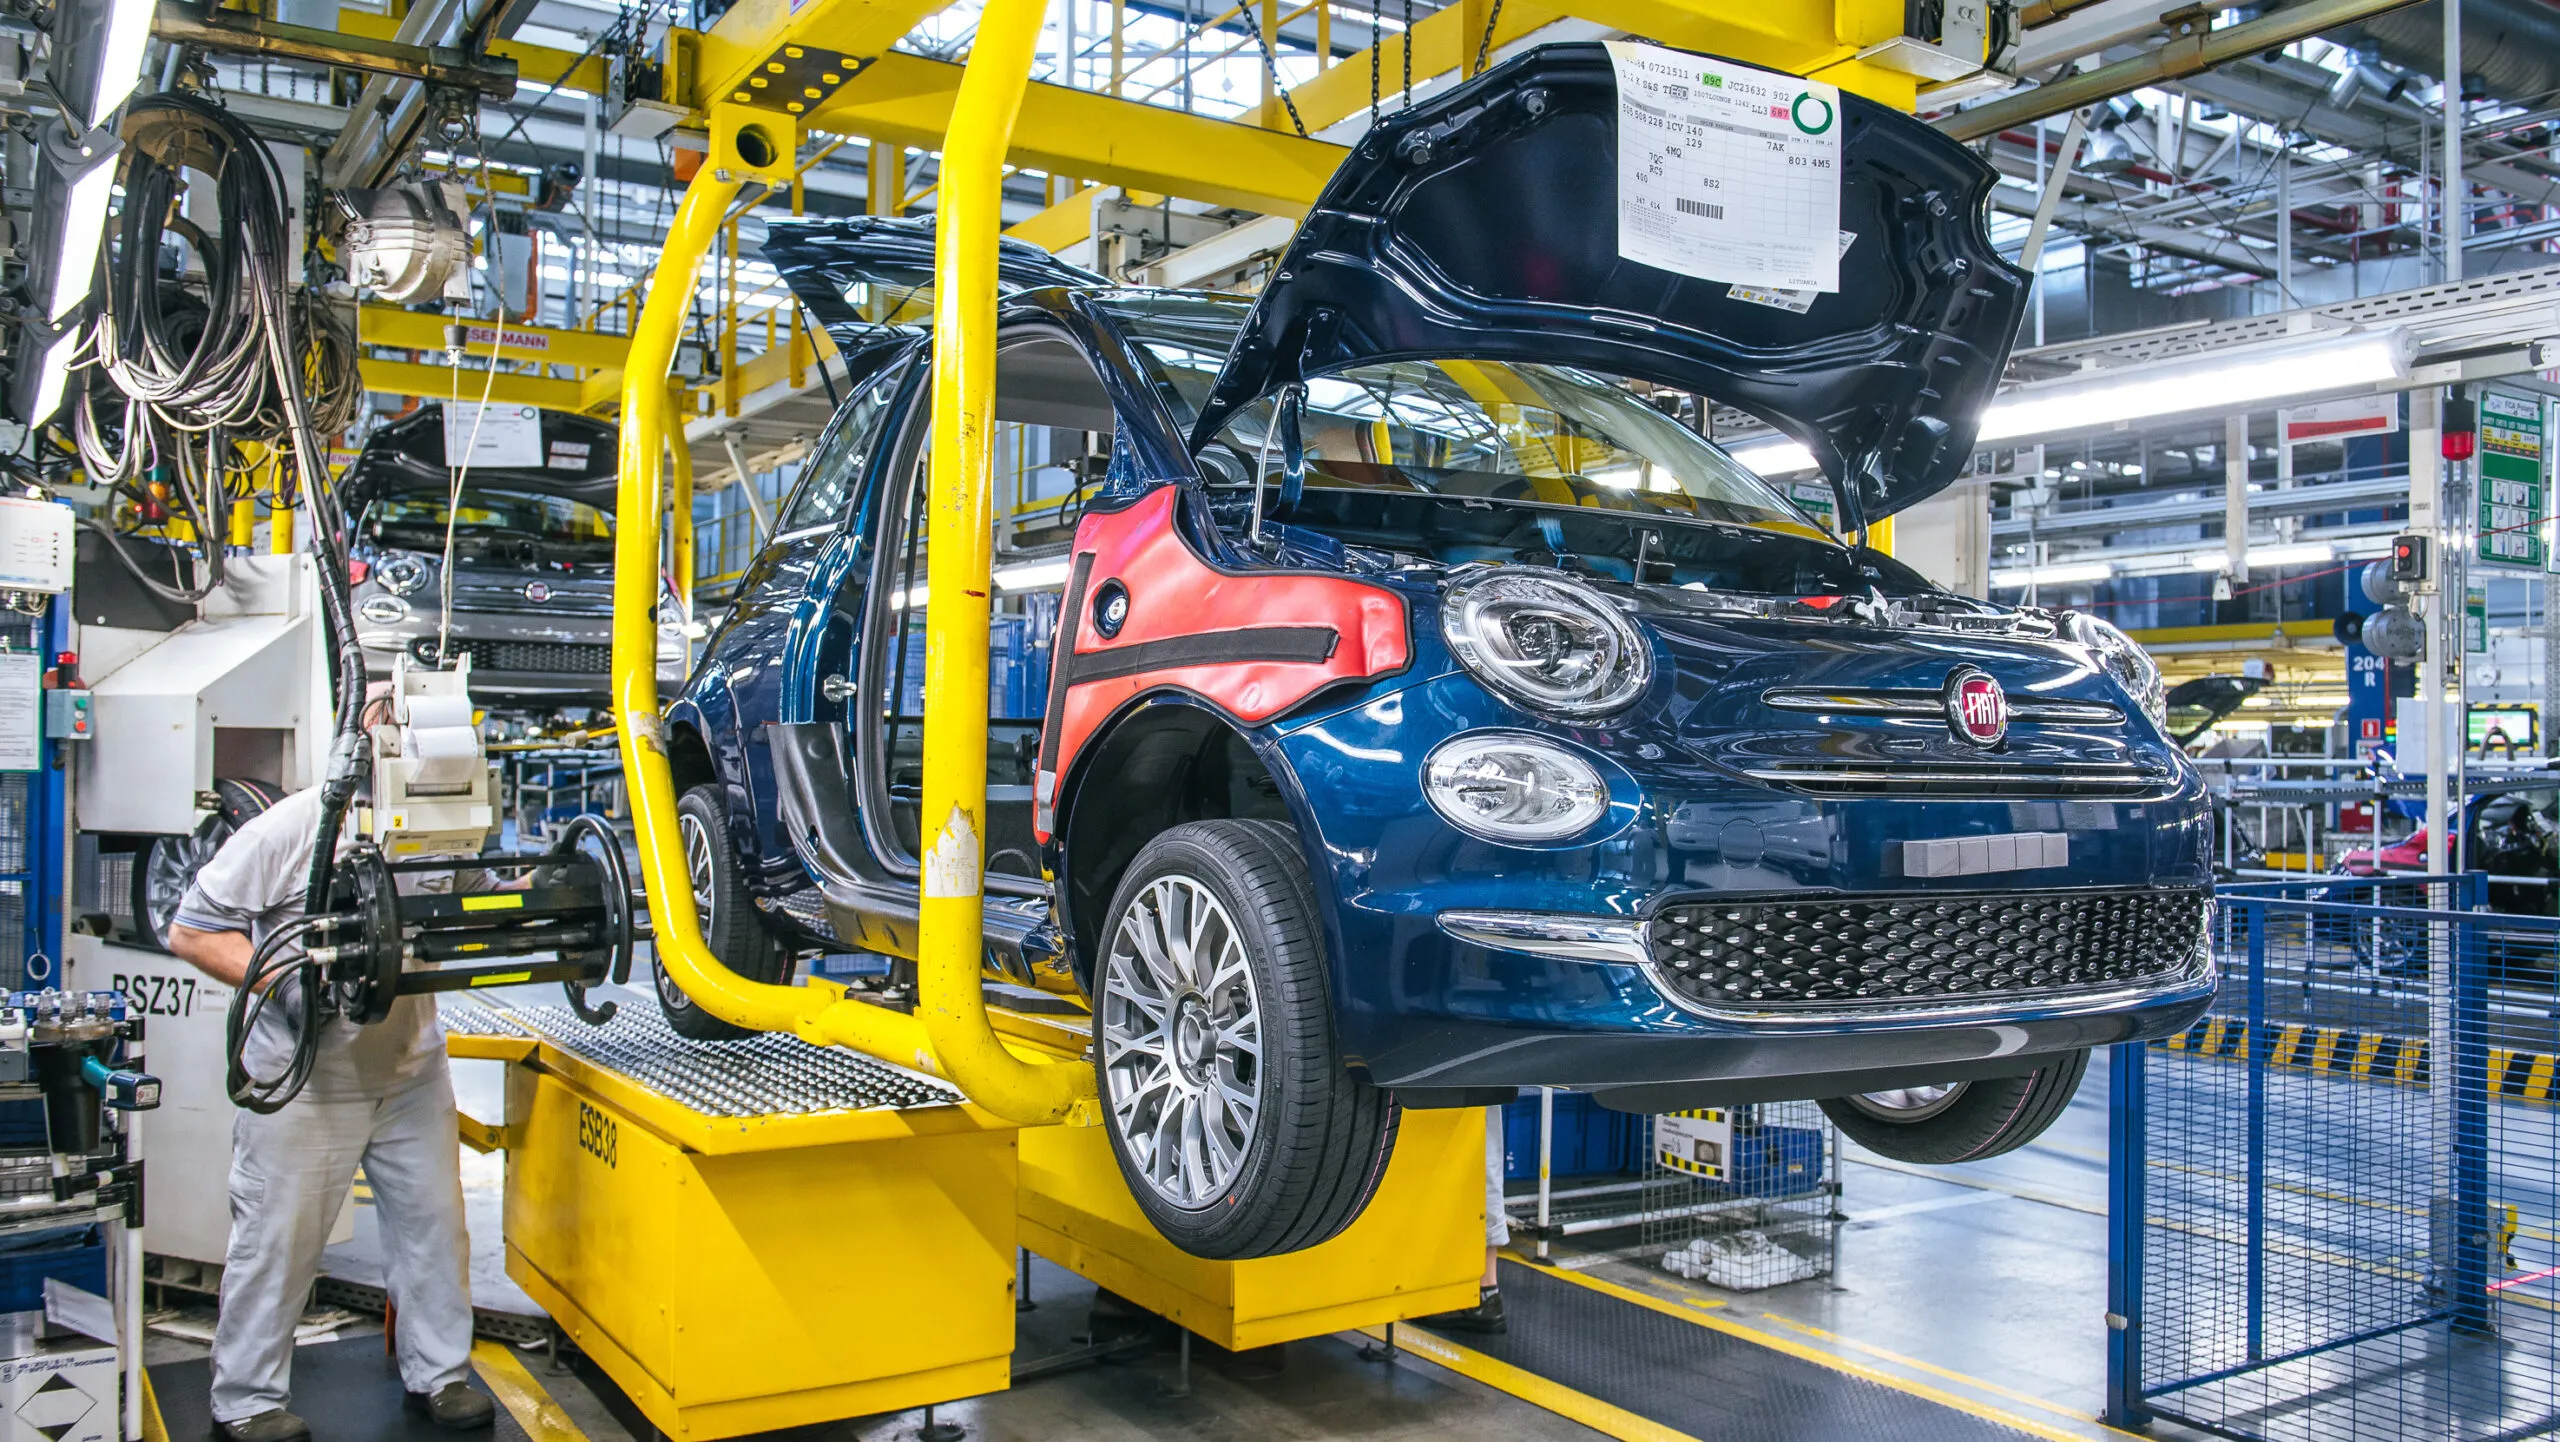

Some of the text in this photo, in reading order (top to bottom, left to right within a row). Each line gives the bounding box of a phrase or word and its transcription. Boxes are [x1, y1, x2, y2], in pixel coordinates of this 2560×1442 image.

[1649, 62, 1689, 79] 0721511
[1695, 73, 1700, 82] 4
[1703, 75, 1721, 87] 09C
[1728, 81, 1767, 97] JC23632
[1773, 91, 1790, 102] 902
[1643, 80, 1659, 92] S&S
[1752, 105, 1768, 116] LL3
[1770, 107, 1789, 119] 687
[1648, 116, 1664, 128] 228
[1666, 121, 1684, 132] 1CV
[1686, 125, 1704, 137] 140
[1665, 145, 1682, 159] 4MQ
[1686, 137, 1785, 152] 129 7AK
[1788, 156, 1807, 166] 803
[1811, 158, 1831, 168] 4M5
[1703, 177, 1720, 189] 8S2
[467, 326, 547, 349] SENMANN
[2353, 656, 2386, 672] 204
[2364, 672, 2377, 688] R
[1966, 692, 1997, 725] FIAT
[579, 1101, 617, 1171] ESB38
